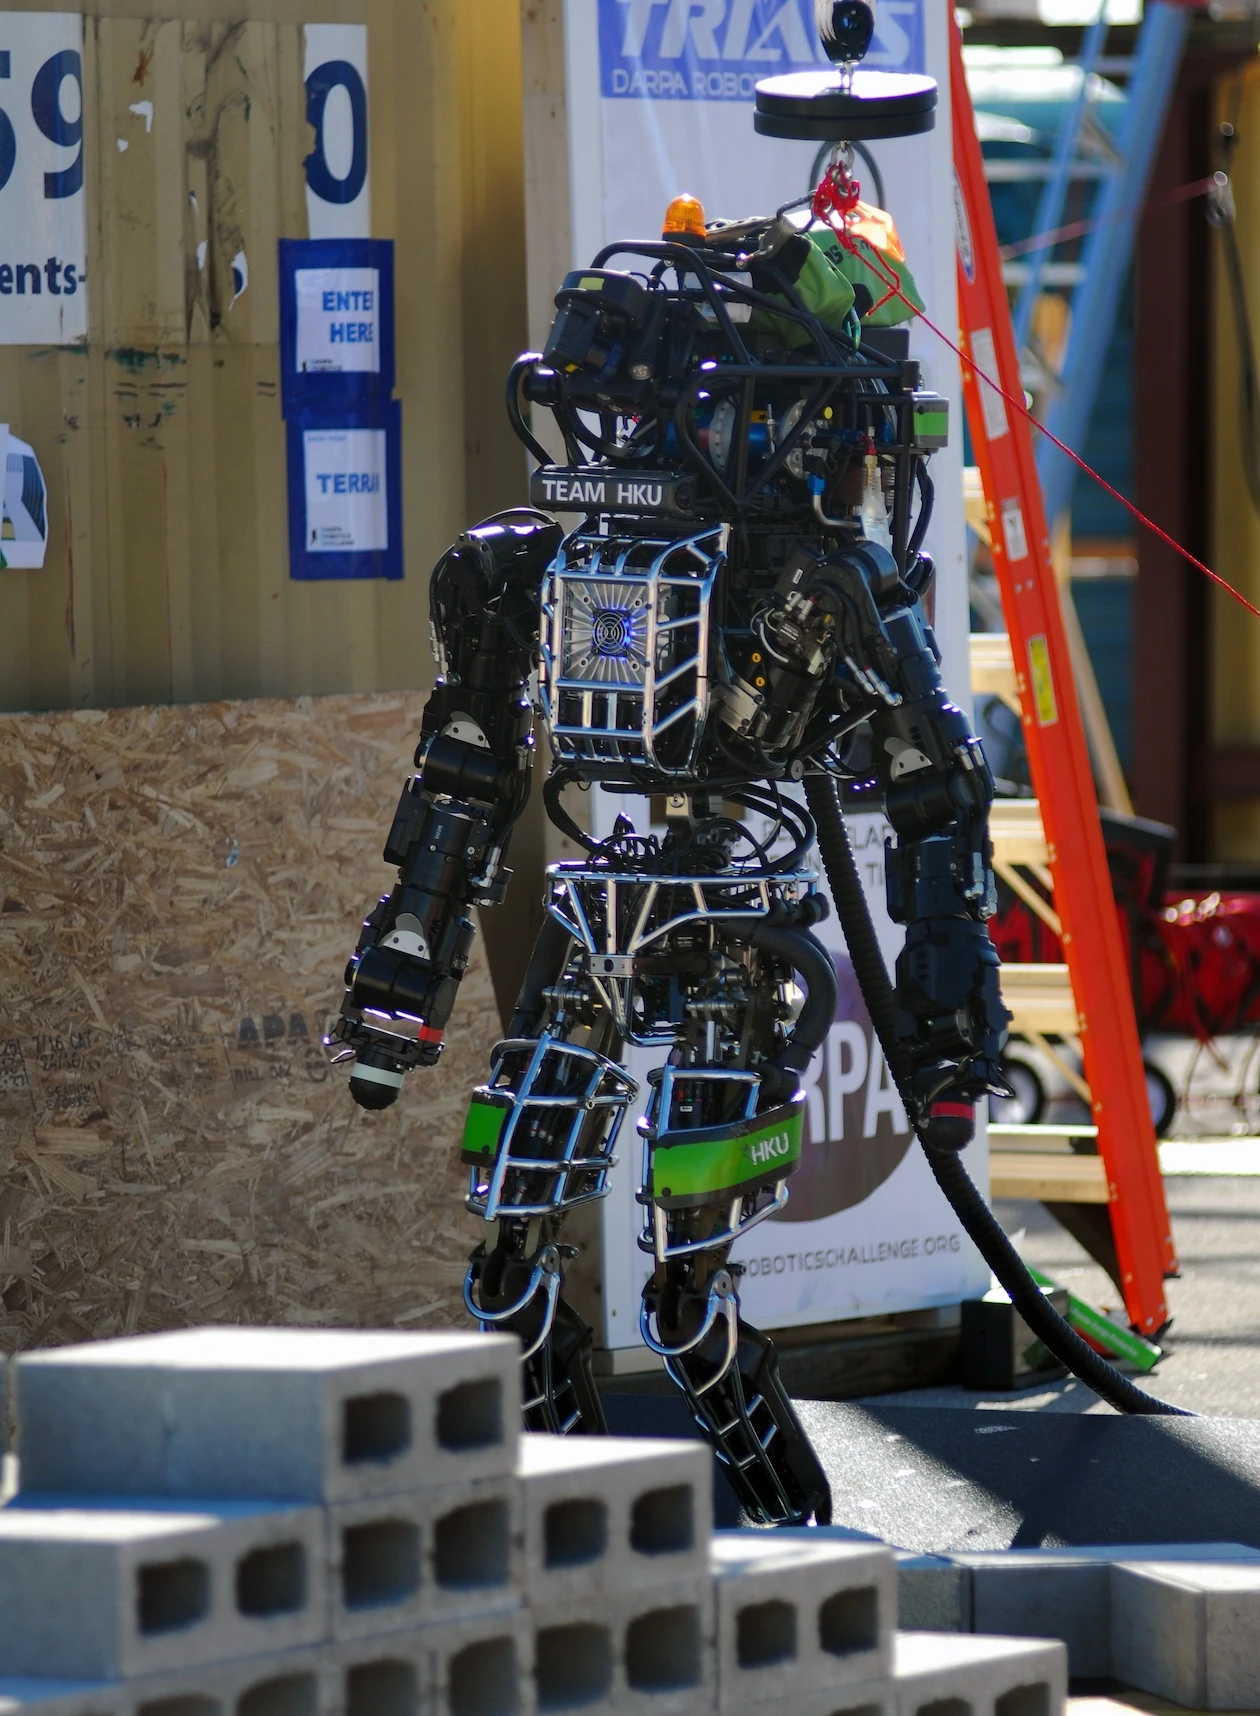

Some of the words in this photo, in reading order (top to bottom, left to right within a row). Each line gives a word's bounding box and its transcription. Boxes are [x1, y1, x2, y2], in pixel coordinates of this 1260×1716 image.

[617, 0, 918, 66] TRIAS
[612, 68, 689, 95] DARPA
[323, 290, 373, 312] ENTE
[542, 479, 606, 503] TEAM
[617, 483, 663, 507] HKU
[751, 1132, 789, 1166] HKU
